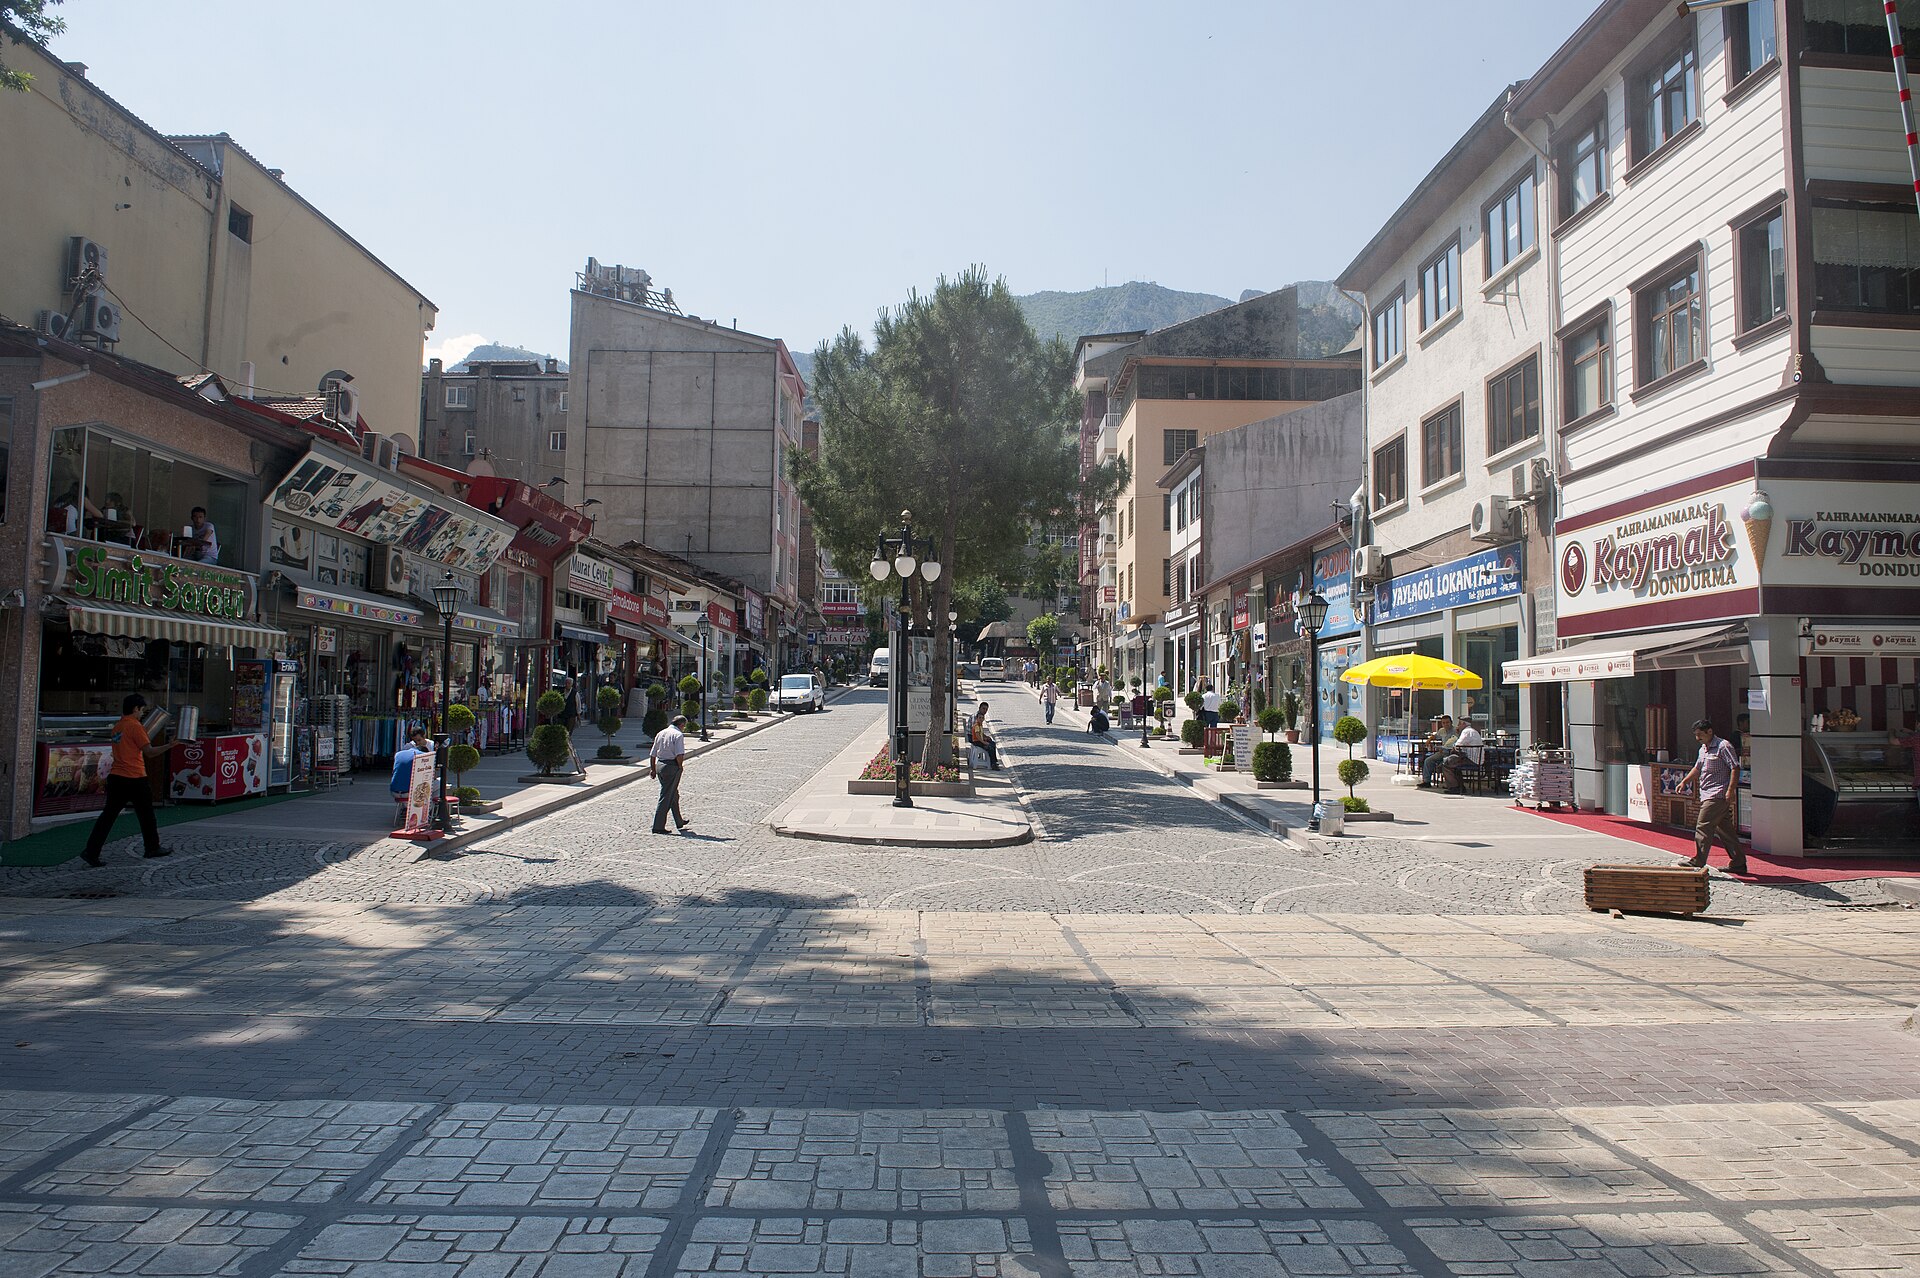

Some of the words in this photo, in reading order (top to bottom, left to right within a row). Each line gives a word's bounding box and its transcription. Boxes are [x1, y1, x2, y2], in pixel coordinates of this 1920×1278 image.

[1616, 502, 1709, 539] KAHRAMANMARAŞ
[1591, 503, 1733, 590] Kaymak
[570, 554, 591, 577] Murat
[591, 562, 608, 585] Çeyiz
[1859, 562, 1920, 578] DONDU
[75, 547, 154, 607] Simit
[162, 563, 245, 620] Sarayı
[1392, 573, 1435, 609] YAYLAGÖL
[1437, 560, 1498, 596] LOKANTASI
[1649, 565, 1738, 598] DONDURMA
[1484, 588, 1491, 598] 03
[1490, 587, 1498, 596] 00
[371, 608, 402, 622] TOYS
[1829, 635, 1862, 645] Kaymak
[1885, 636, 1917, 645] Kaymak
[1614, 661, 1631, 670] Kaymak
[1629, 797, 1650, 807] Kaymak
